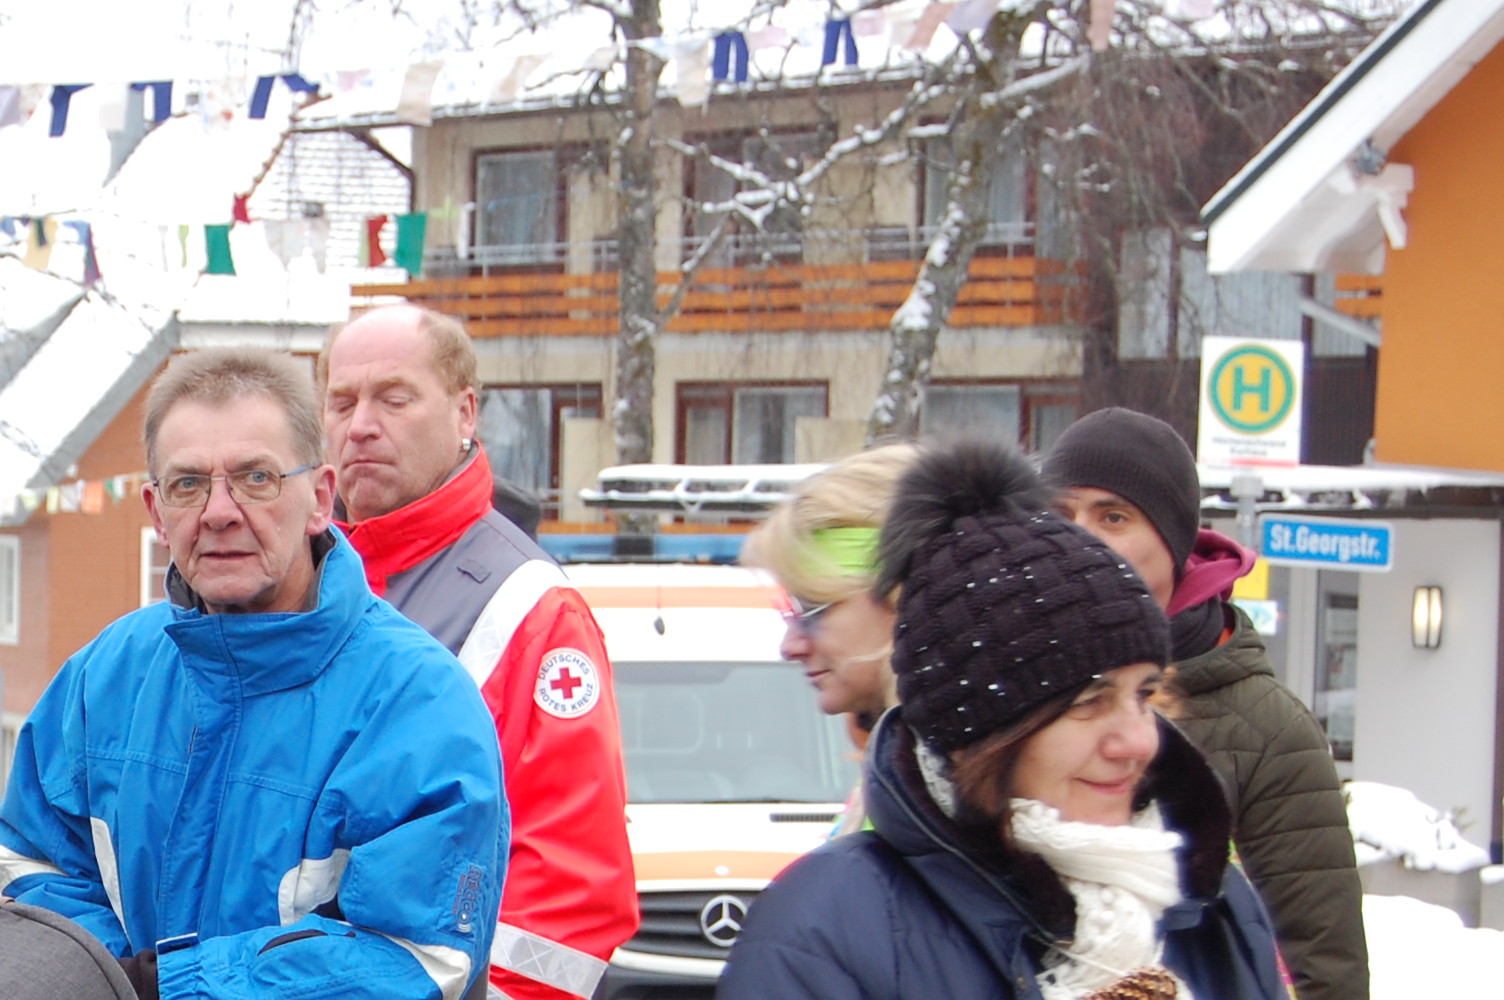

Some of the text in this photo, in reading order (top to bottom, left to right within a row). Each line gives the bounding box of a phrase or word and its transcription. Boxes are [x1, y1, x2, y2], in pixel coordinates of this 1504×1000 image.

[1232, 365, 1272, 413] H
[1269, 523, 1382, 562] St.Georgstr.
[538, 653, 590, 680] DEUTSCHES
[539, 687, 567, 712] ROTES
[571, 683, 593, 711] KREUZ
